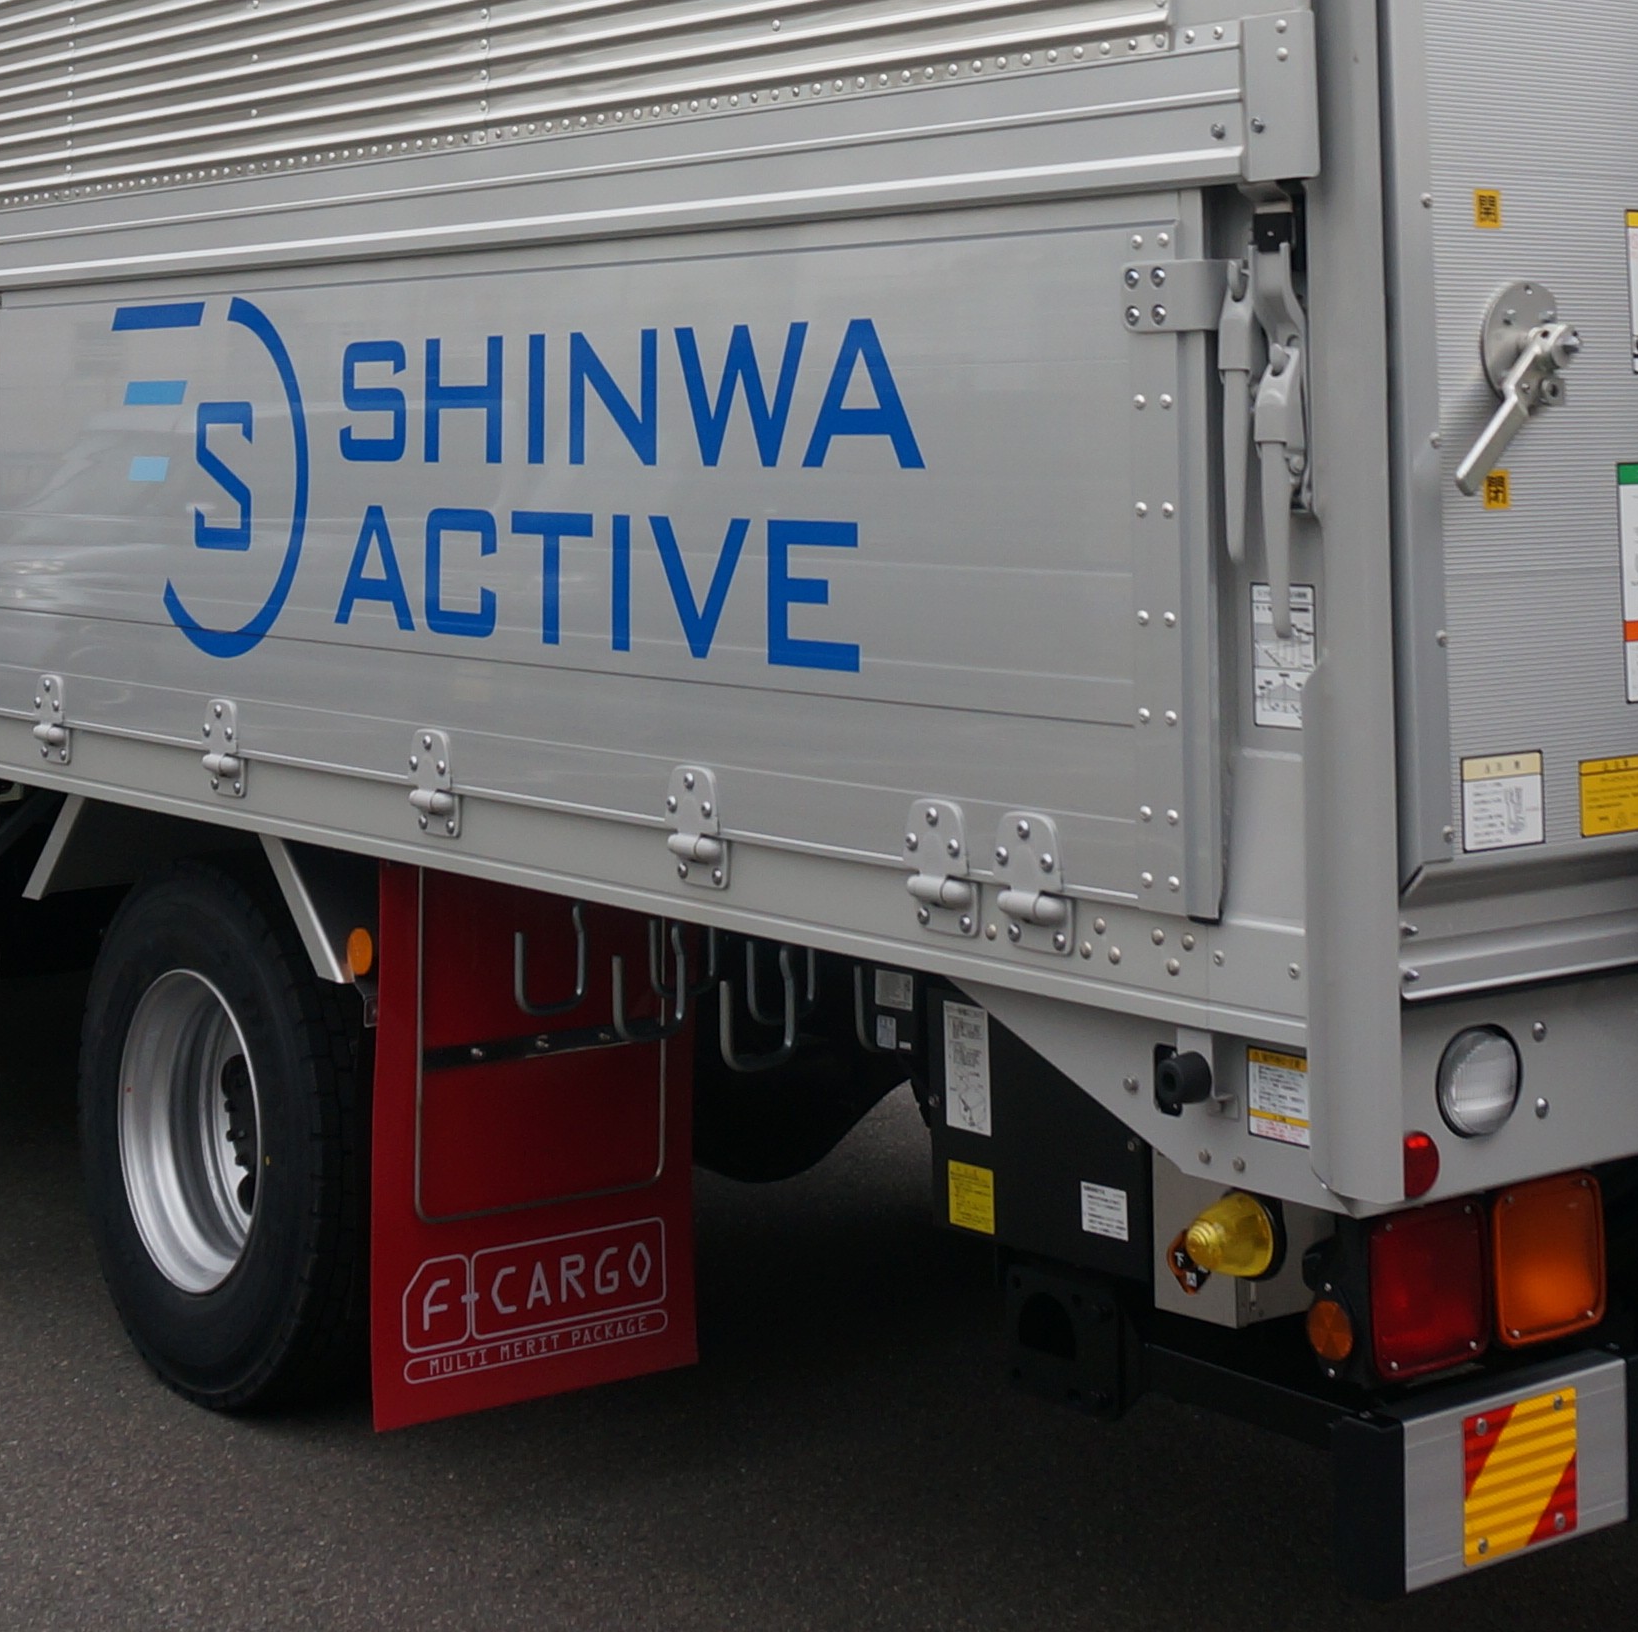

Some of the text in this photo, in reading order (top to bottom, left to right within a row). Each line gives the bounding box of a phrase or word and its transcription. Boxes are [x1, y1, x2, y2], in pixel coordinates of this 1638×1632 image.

[339, 317, 926, 470] SHINWA
[334, 505, 861, 673] ACTIVE
[428, 1315, 649, 1376] MULTI MERIT PACKAGE
